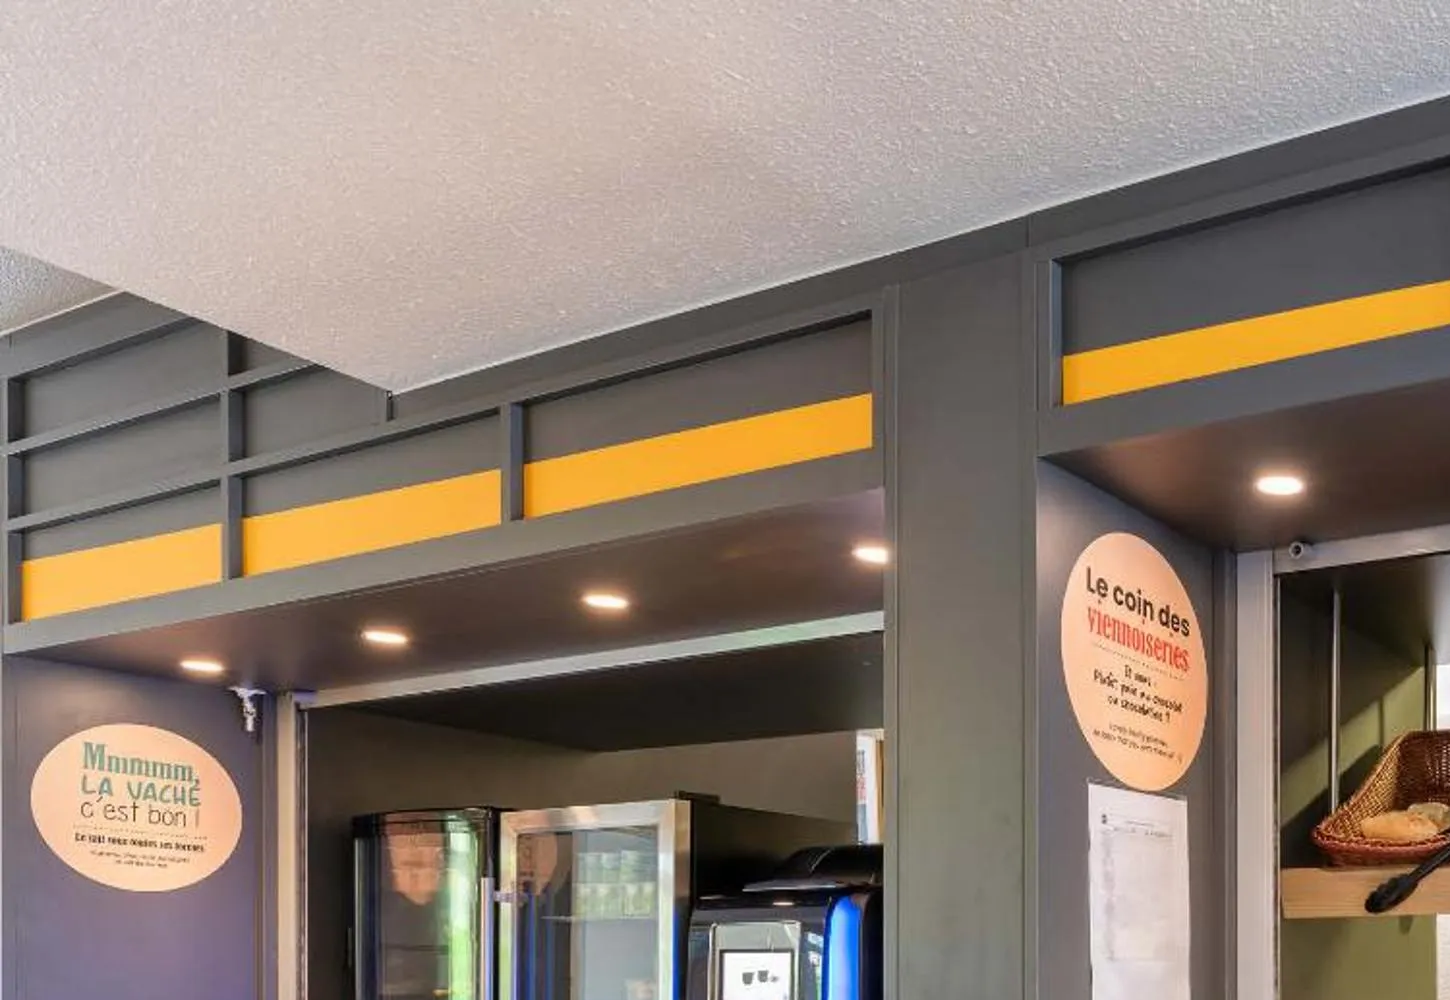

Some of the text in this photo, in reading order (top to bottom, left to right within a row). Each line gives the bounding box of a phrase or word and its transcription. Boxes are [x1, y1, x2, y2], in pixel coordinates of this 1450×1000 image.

[1085, 566, 1191, 637] Le coin des
[81, 774, 202, 808] LA VACHE
[80, 796, 140, 823] c'est
[148, 804, 187, 828] bon
